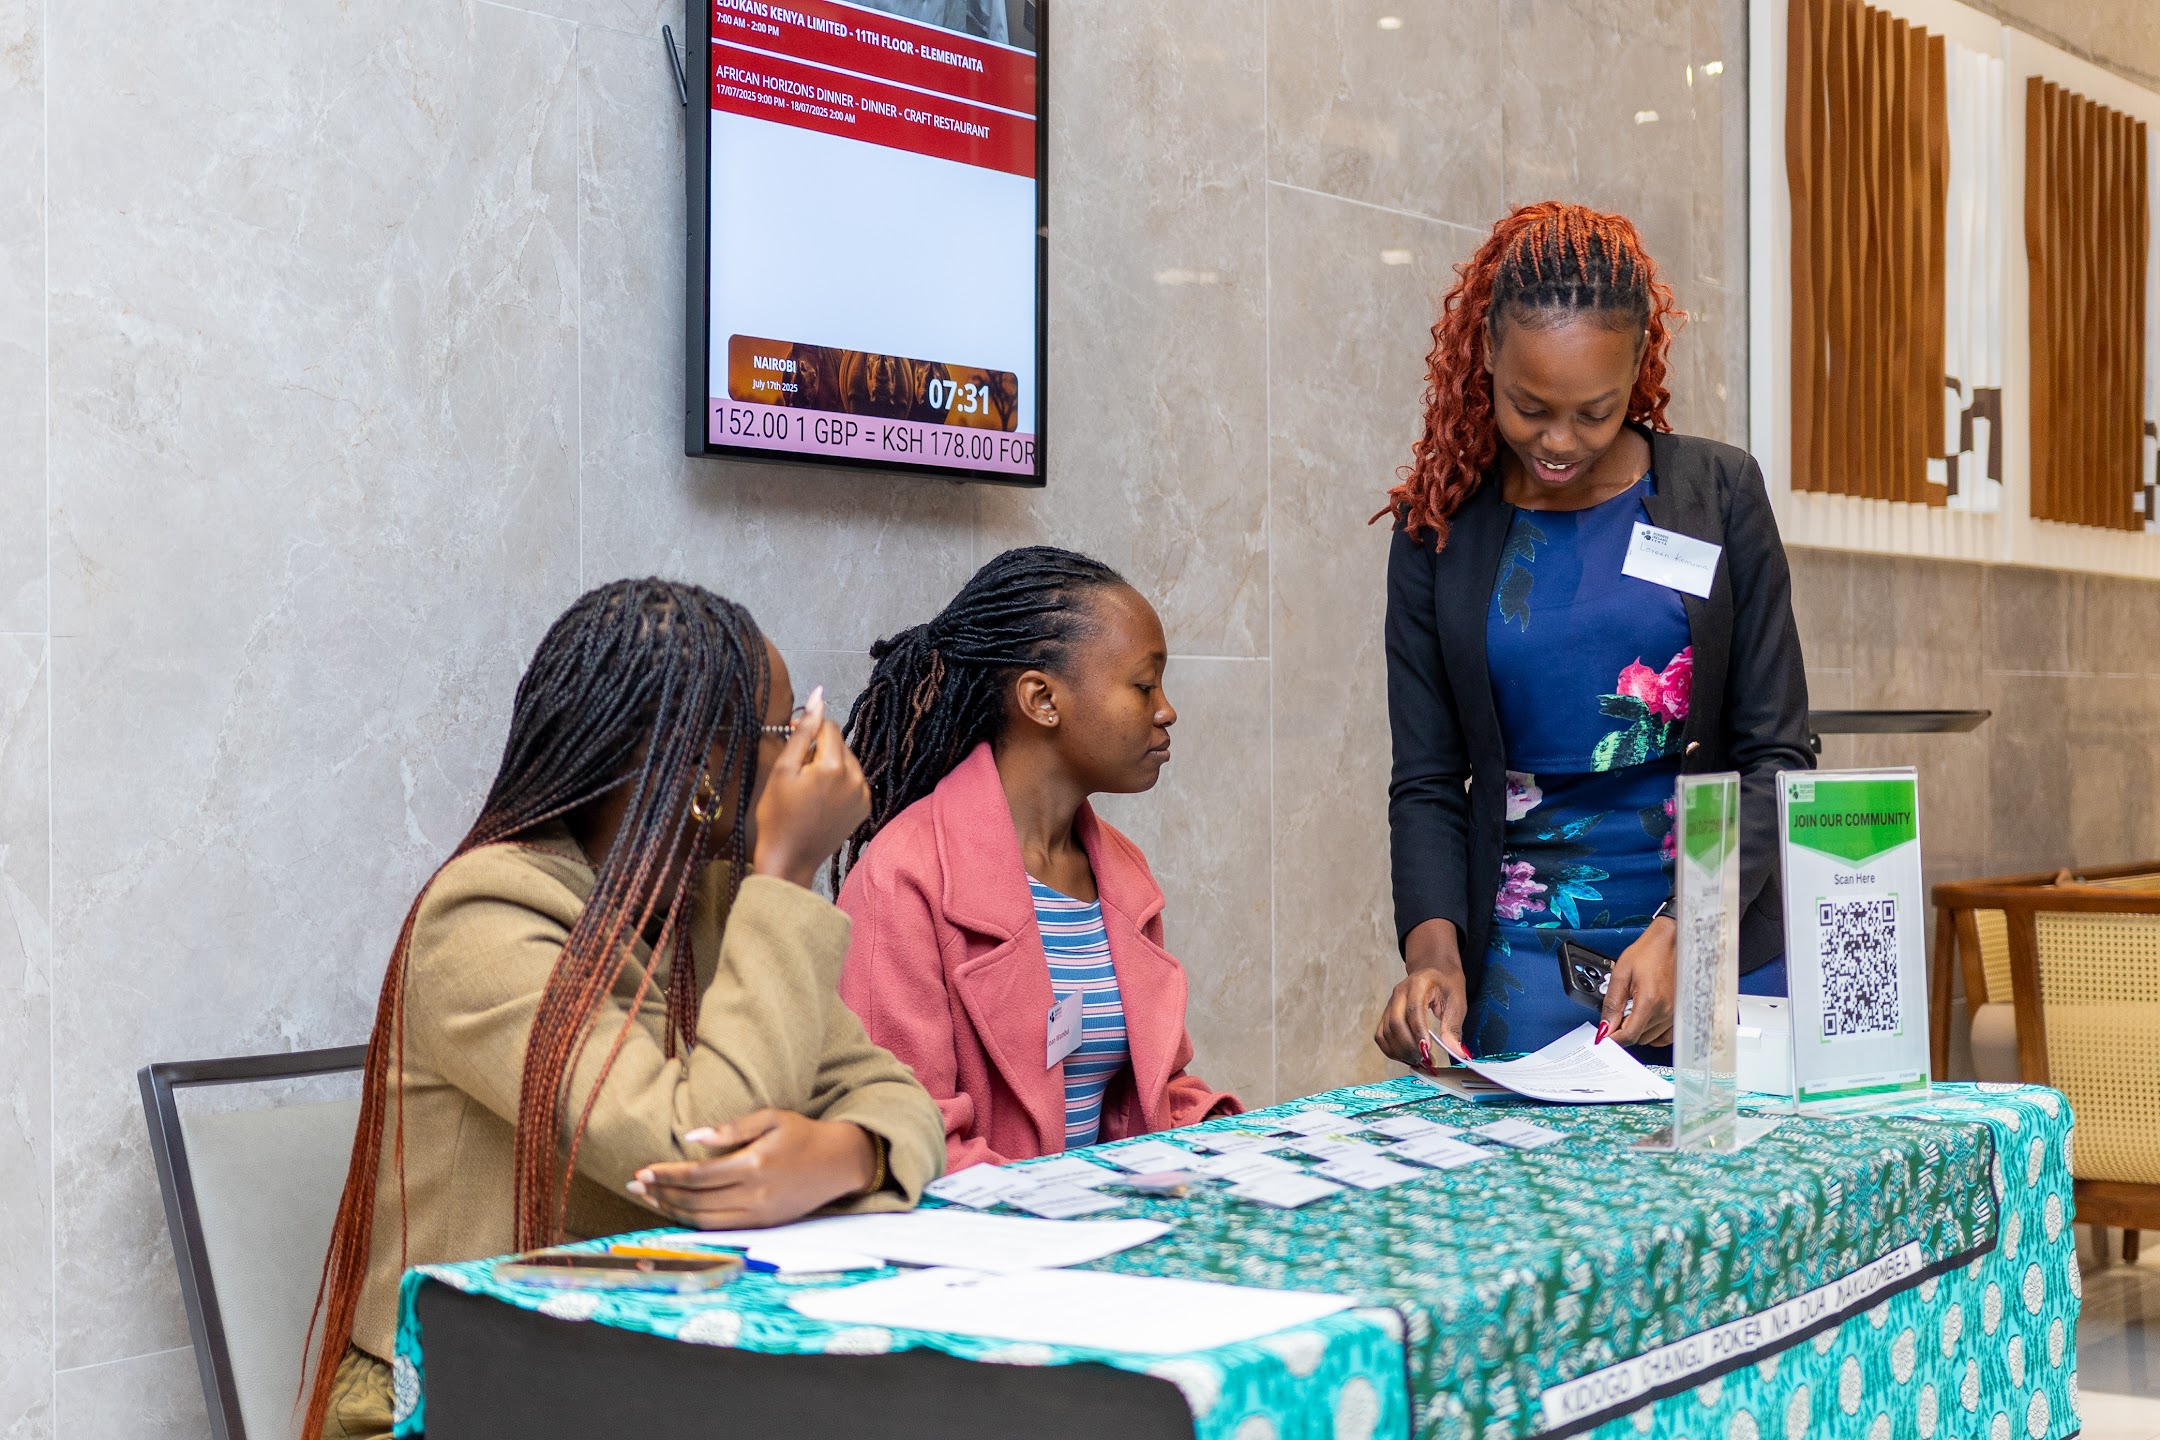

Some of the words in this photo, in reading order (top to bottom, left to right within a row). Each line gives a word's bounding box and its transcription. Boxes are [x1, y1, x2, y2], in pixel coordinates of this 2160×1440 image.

[716, 11, 733, 25] 7:00
[733, 16, 746, 28] AM
[751, 20, 767, 33] 2:00
[767, 25, 780, 37] PM
[770, 6, 805, 27] KENYA
[807, 15, 847, 37] LIMITED
[855, 28, 880, 46] 11TH
[881, 34, 914, 55] FLOOR
[920, 45, 984, 72] ELEMENTAITA
[716, 64, 760, 86] AFRICAN
[762, 75, 815, 99] HORIZONS
[816, 87, 854, 108] DINNER
[861, 97, 897, 118] DINNER
[904, 108, 932, 126] CRAFT
[933, 115, 990, 139] RESTAURANT
[716, 84, 756, 101] 17/07/2025
[757, 92, 773, 105] 9:00
[773, 96, 786, 108] PM
[790, 100, 828, 118] 18/07/2025
[829, 109, 844, 121] 2:00
[844, 112, 856, 124] AM
[753, 355, 797, 374] NAIROBI
[752, 378, 765, 392] July
[766, 379, 781, 391] 17th
[781, 382, 798, 393] 2025
[928, 378, 989, 415] 07:31
[715, 406, 788, 440] 152.00
[796, 416, 804, 442] 1
[815, 418, 858, 446] GBP
[865, 430, 875, 442] =
[883, 425, 923, 454] KSH
[930, 431, 993, 461] 178.00
[1000, 438, 1035, 466] FOR
[1794, 814, 1817, 828] JOIN
[1819, 813, 1842, 827] OUR
[1845, 812, 1911, 827] COMMUNITY
[1834, 873, 1854, 885] Scan
[1856, 872, 1875, 884] Here
[1562, 1367, 1632, 1414] KIDOGO
[1712, 1318, 1762, 1355] POKEA
[1772, 1308, 1792, 1334] NA
